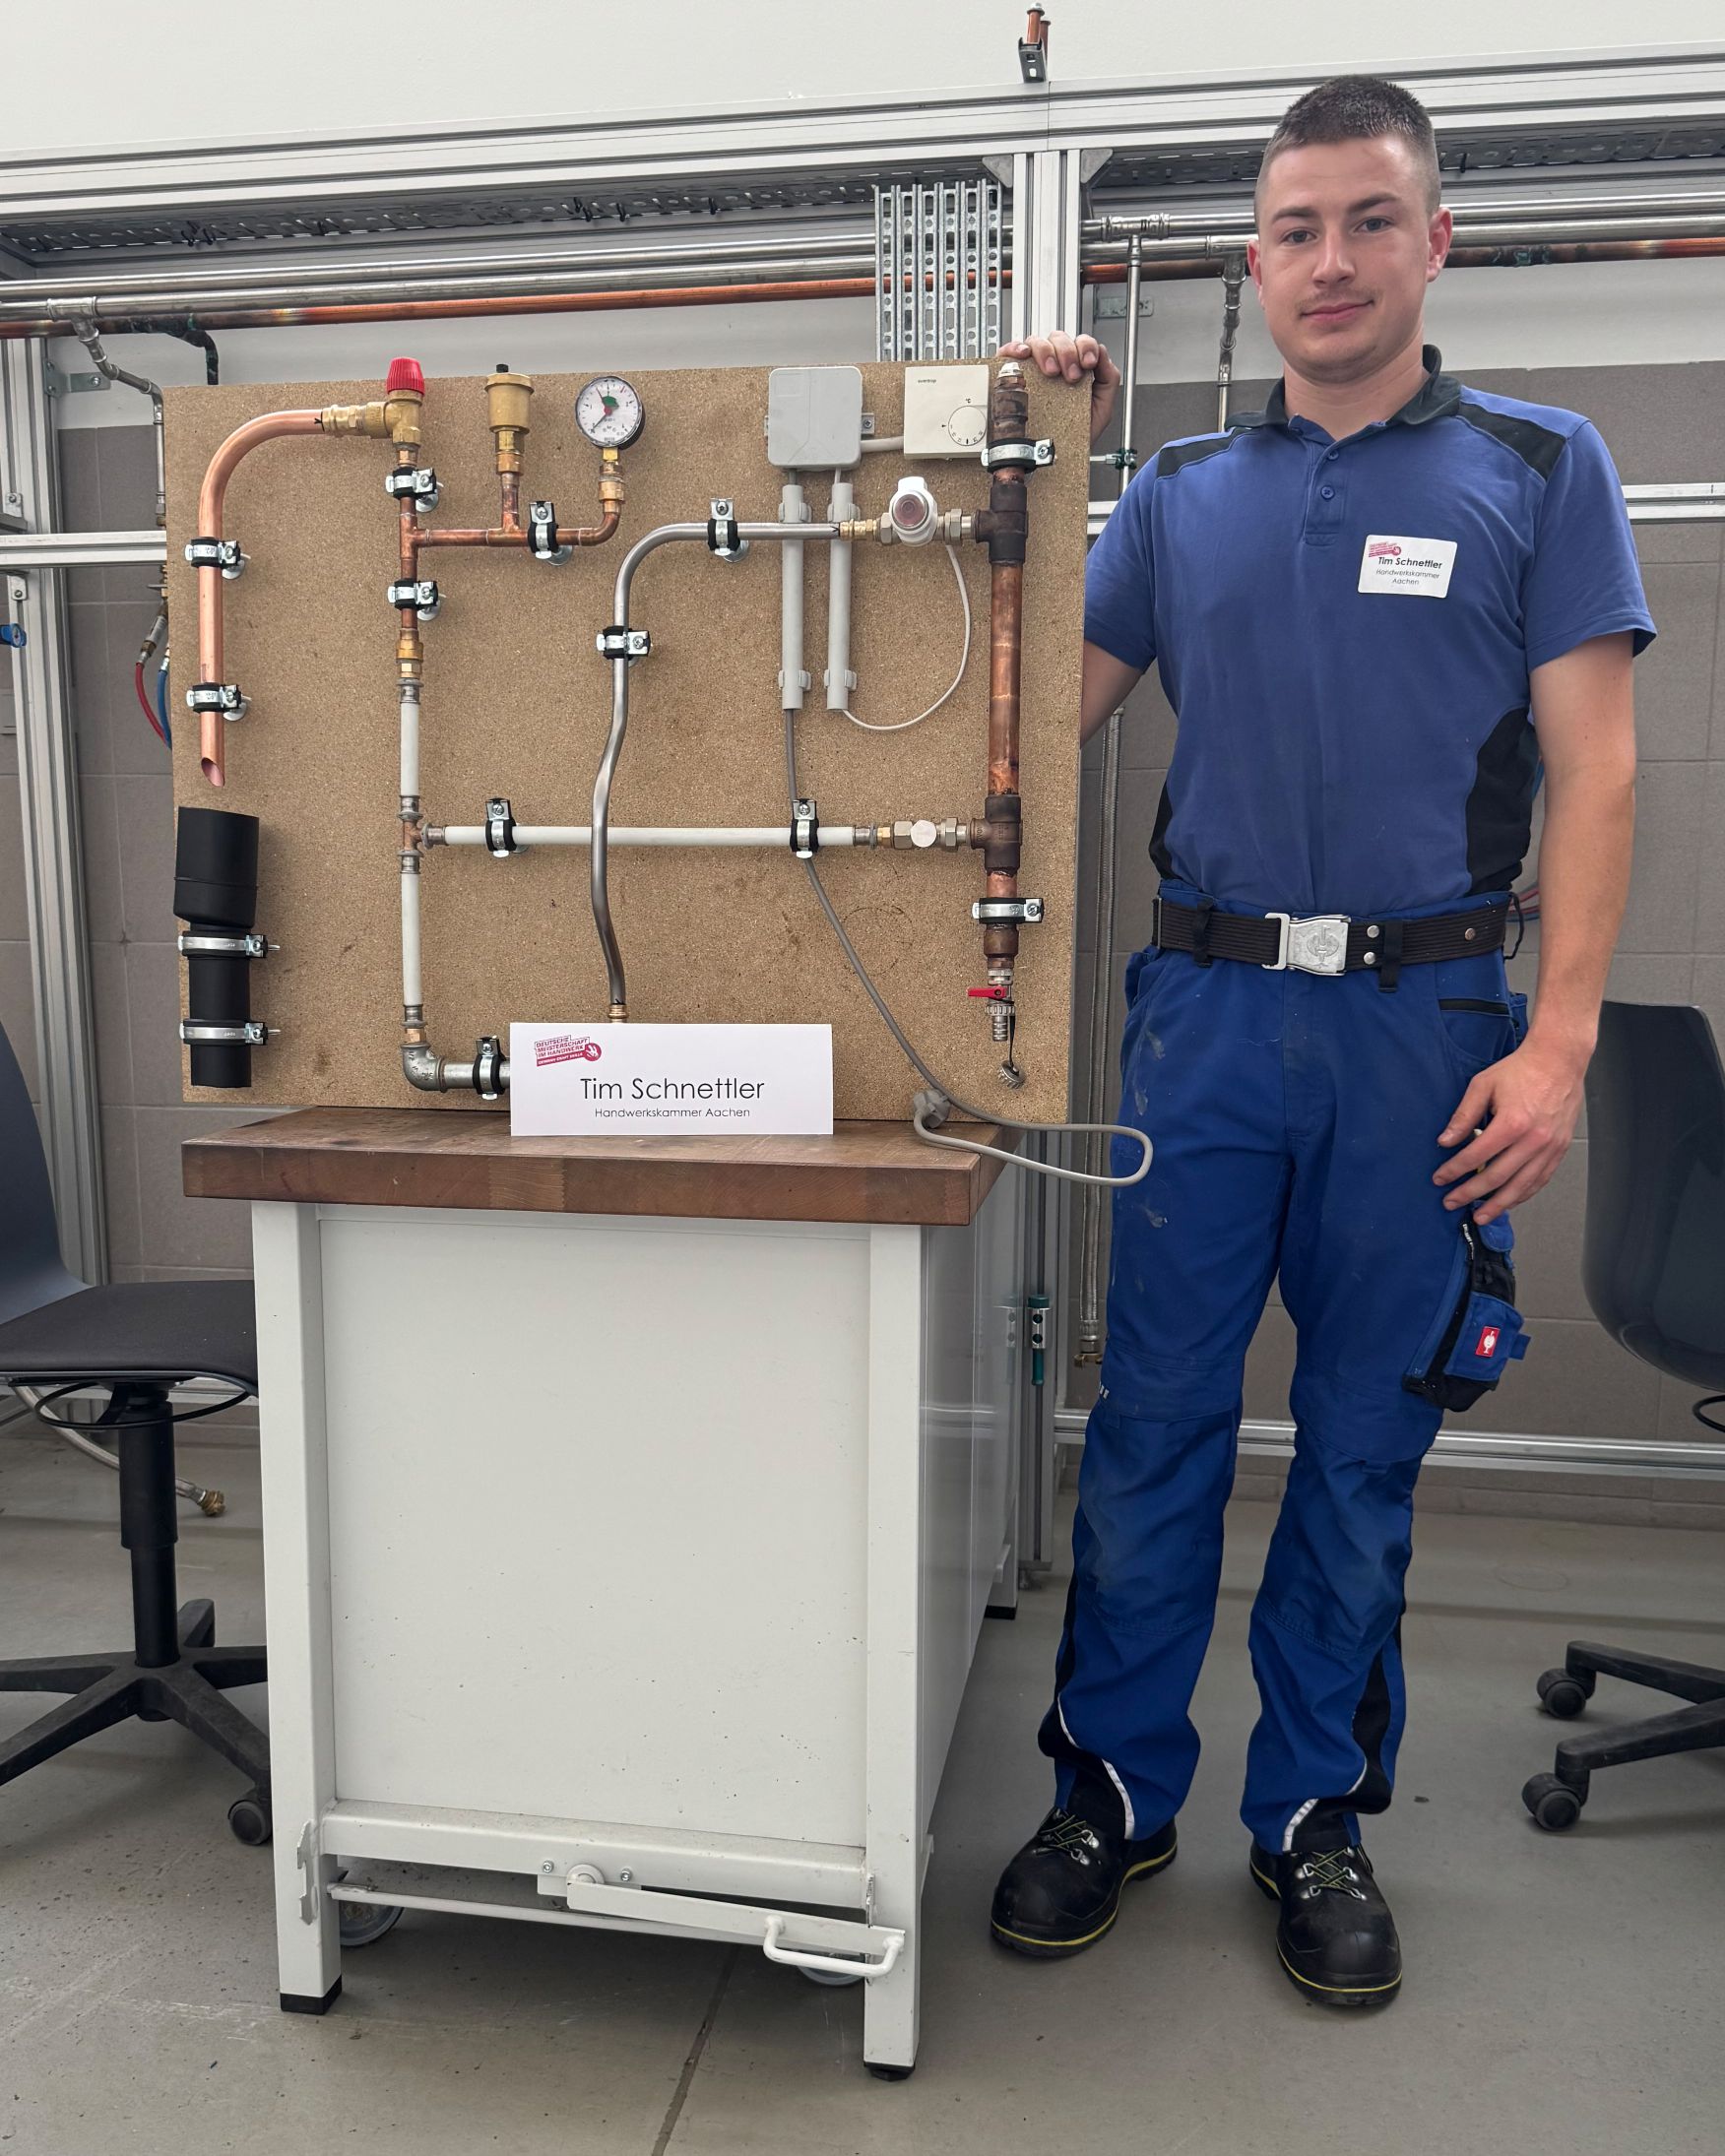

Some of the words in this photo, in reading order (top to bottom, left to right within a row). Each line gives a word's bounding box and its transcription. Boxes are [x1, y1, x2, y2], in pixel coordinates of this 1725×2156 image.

[1378, 556, 1393, 566] Tim
[1395, 557, 1442, 569] Schnettler
[1375, 569, 1439, 579] Handwerkskammer
[537, 1038, 569, 1047] DEUTSCHE
[537, 1039, 588, 1052] MEISTERSCHAFT
[547, 1045, 584, 1055] HANDWERK
[580, 1077, 622, 1100] Tim
[631, 1077, 765, 1100] Schnettler
[595, 1108, 702, 1117] Handwerkskammer
[705, 1108, 750, 1117] Aachen
